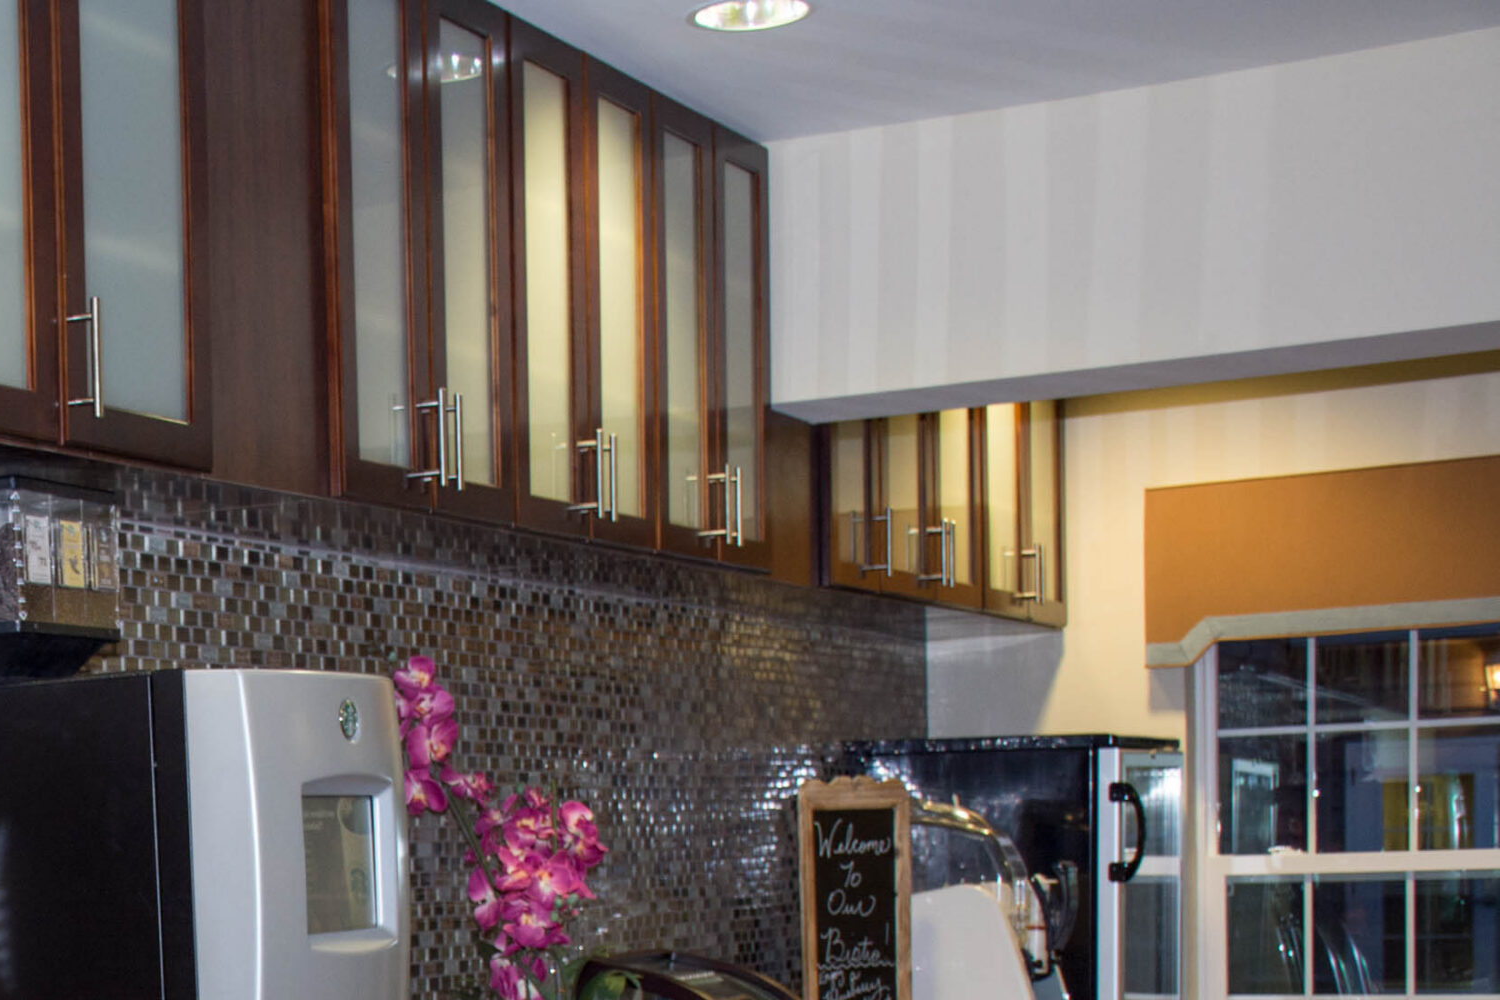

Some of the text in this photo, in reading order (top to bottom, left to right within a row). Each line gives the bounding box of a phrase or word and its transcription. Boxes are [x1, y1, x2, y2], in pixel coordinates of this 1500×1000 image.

[814, 818, 892, 859] Welcome
[840, 860, 862, 888] To
[827, 888, 876, 918] Our
